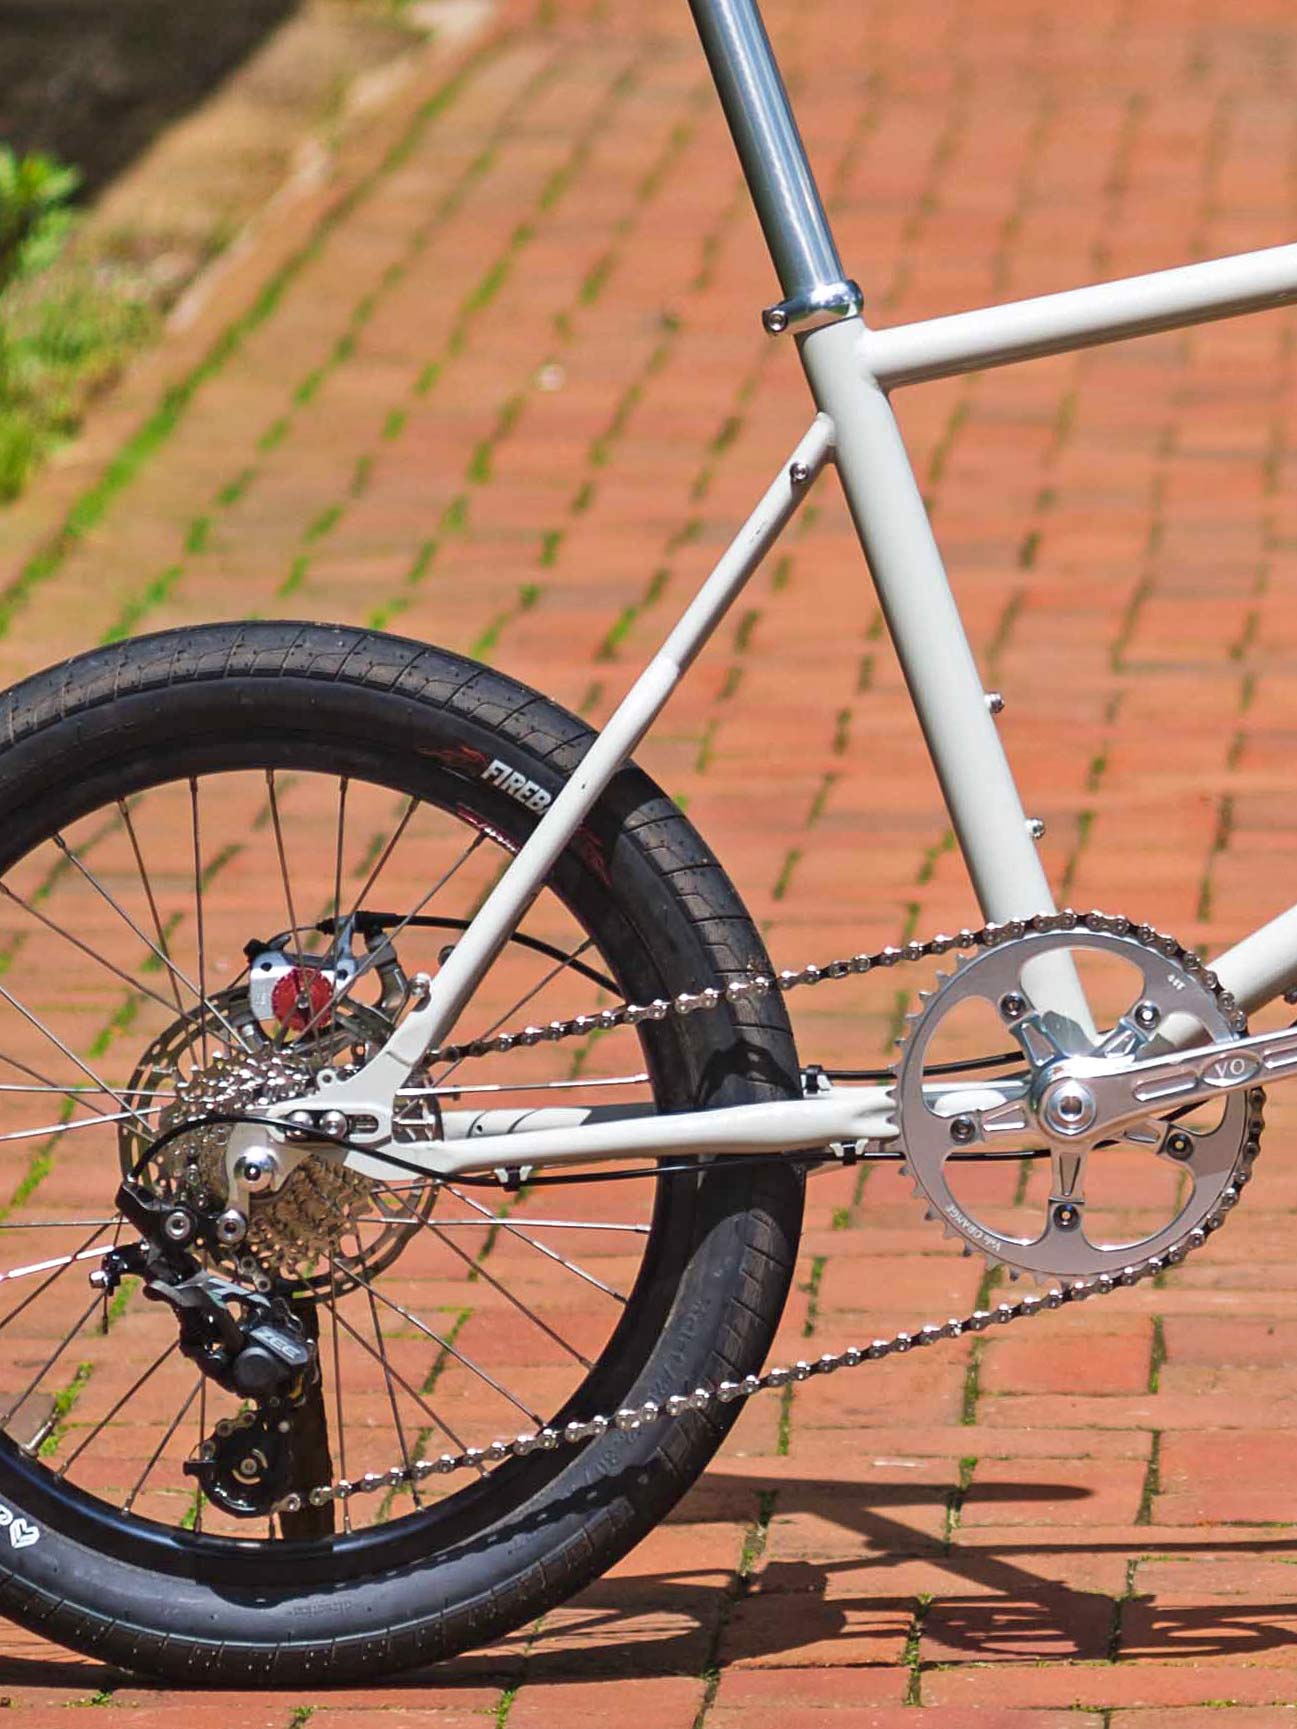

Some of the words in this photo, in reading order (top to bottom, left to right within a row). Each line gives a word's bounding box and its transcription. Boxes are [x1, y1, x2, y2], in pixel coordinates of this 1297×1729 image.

[481, 759, 552, 815] FIREB
[1214, 1058, 1245, 1078] VO
[253, 1329, 302, 1360] ZEE
